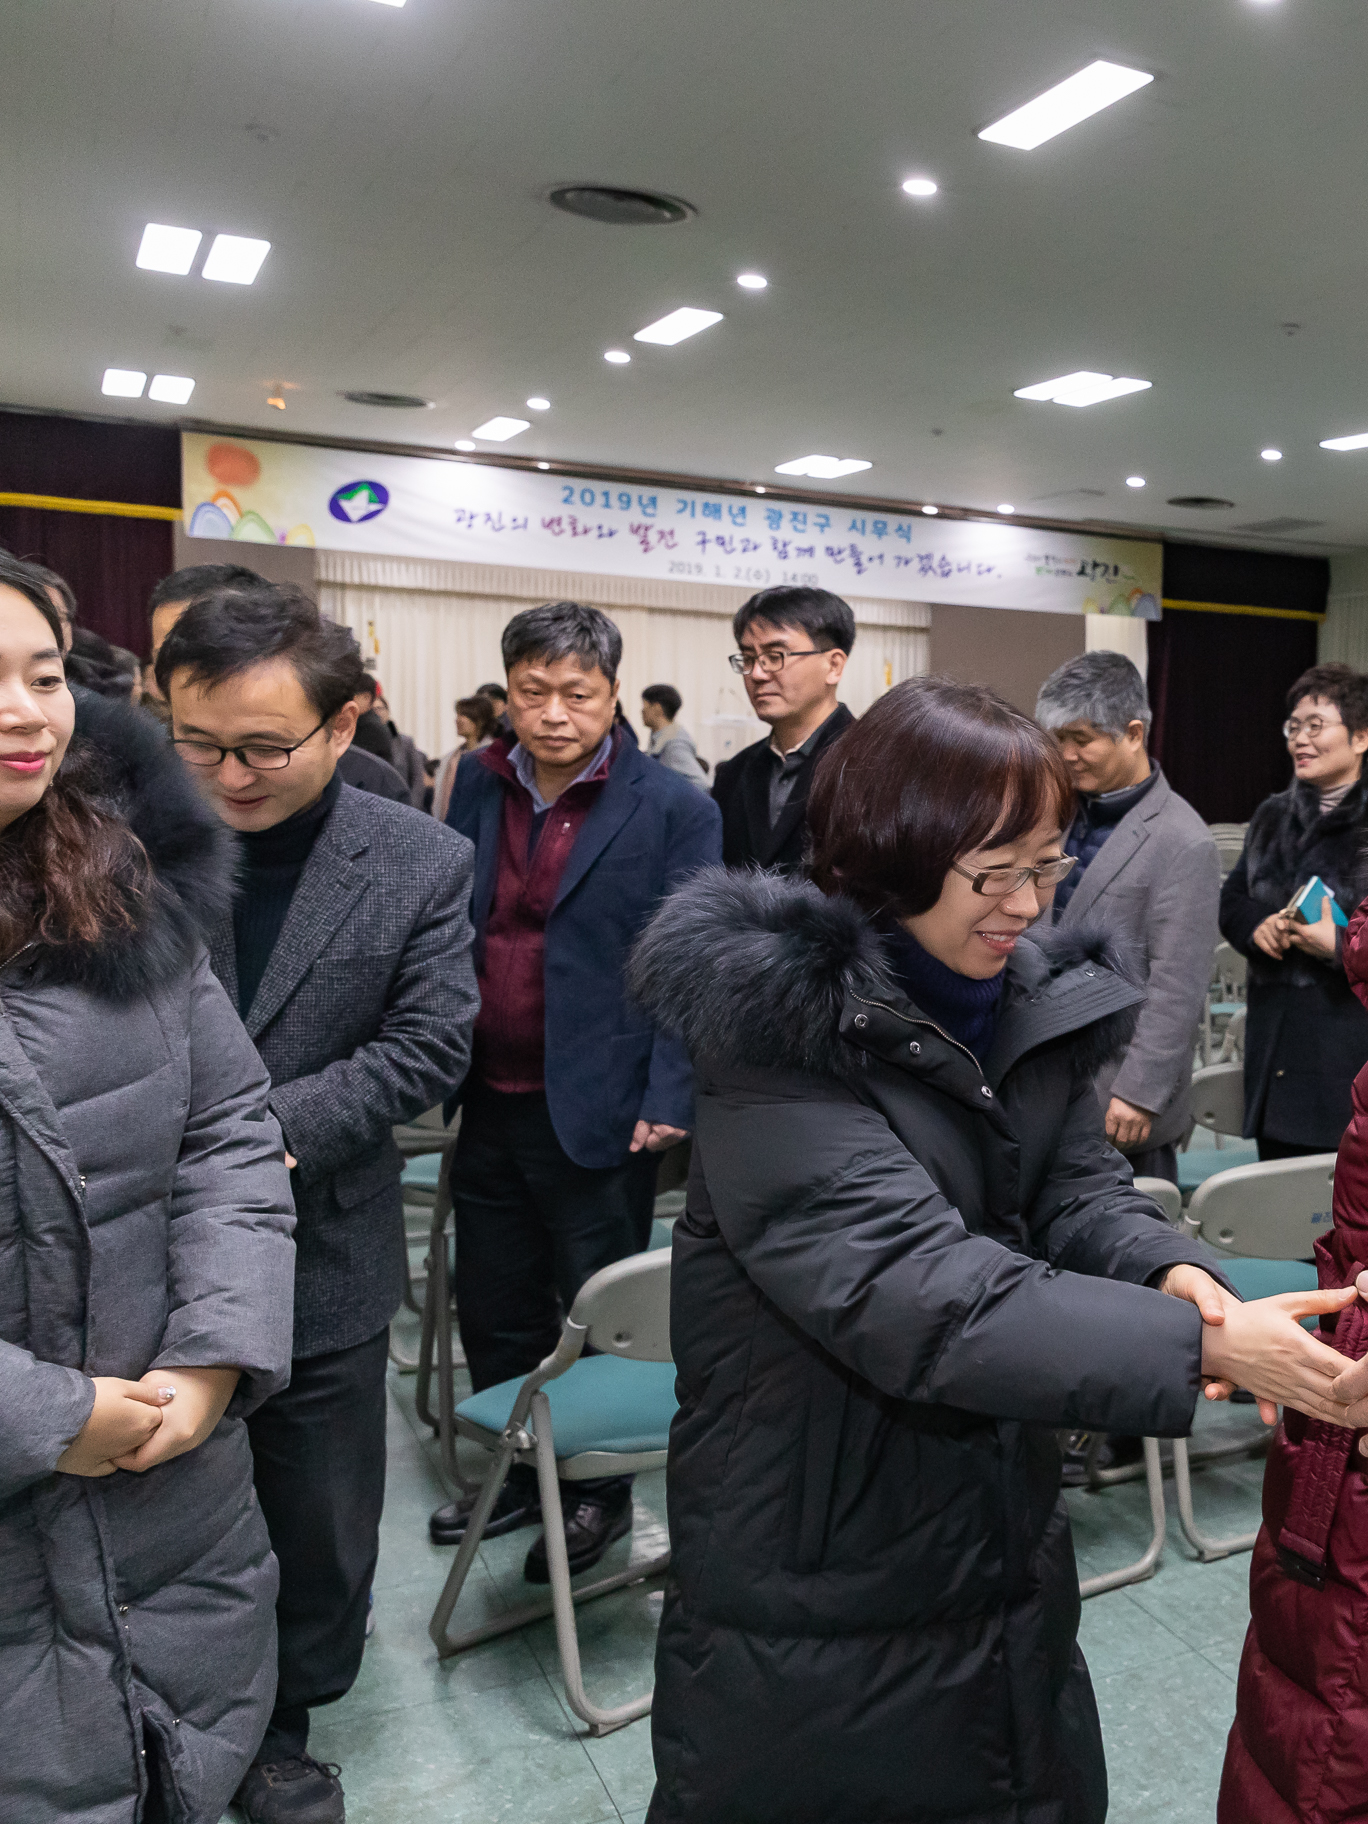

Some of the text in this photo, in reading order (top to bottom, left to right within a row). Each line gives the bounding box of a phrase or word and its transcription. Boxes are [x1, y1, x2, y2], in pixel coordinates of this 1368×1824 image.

[453, 508, 529, 533] 광진의
[541, 514, 618, 539] 변화와
[629, 521, 679, 554] 발전
[696, 530, 762, 555] 구민과
[771, 536, 816, 560] 함께
[825, 543, 885, 576] 만들어
[562, 485, 912, 544] 2019년 기해년 광진구 시무식
